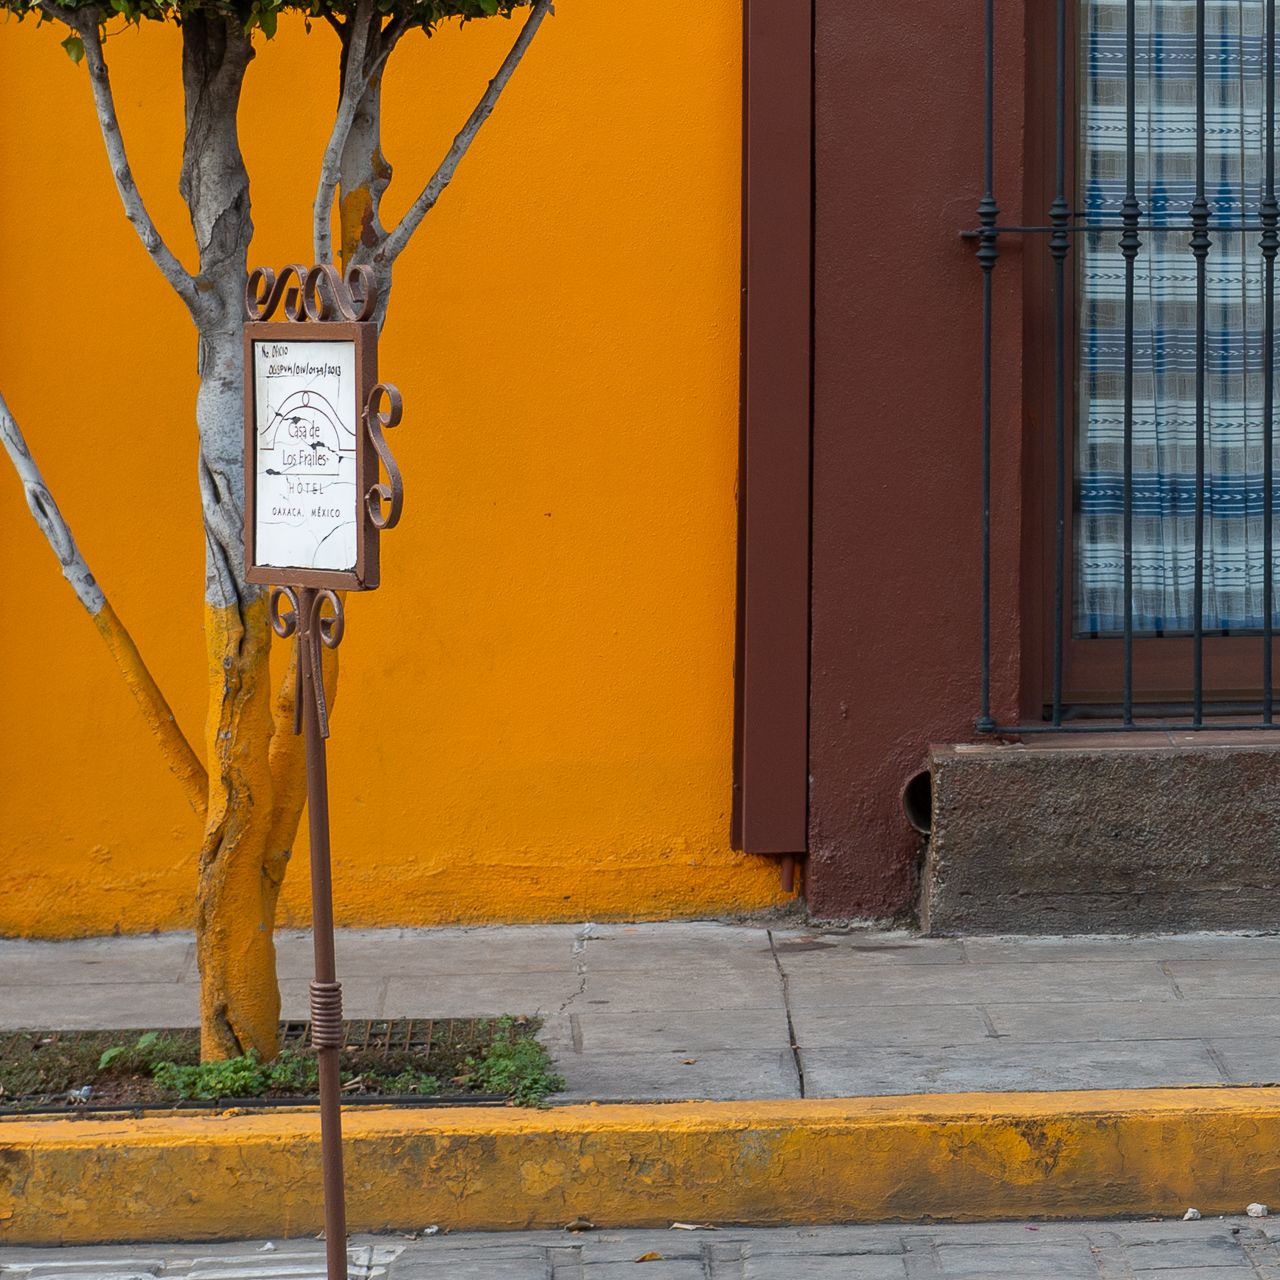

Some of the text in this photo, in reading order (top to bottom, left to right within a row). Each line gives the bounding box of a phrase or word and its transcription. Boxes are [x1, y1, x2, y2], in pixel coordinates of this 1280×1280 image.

[288, 420, 320, 439] Casa de
[282, 449, 297, 466] Los
[289, 482, 324, 495] HOTEL
[311, 506, 341, 518] MÉXICO
